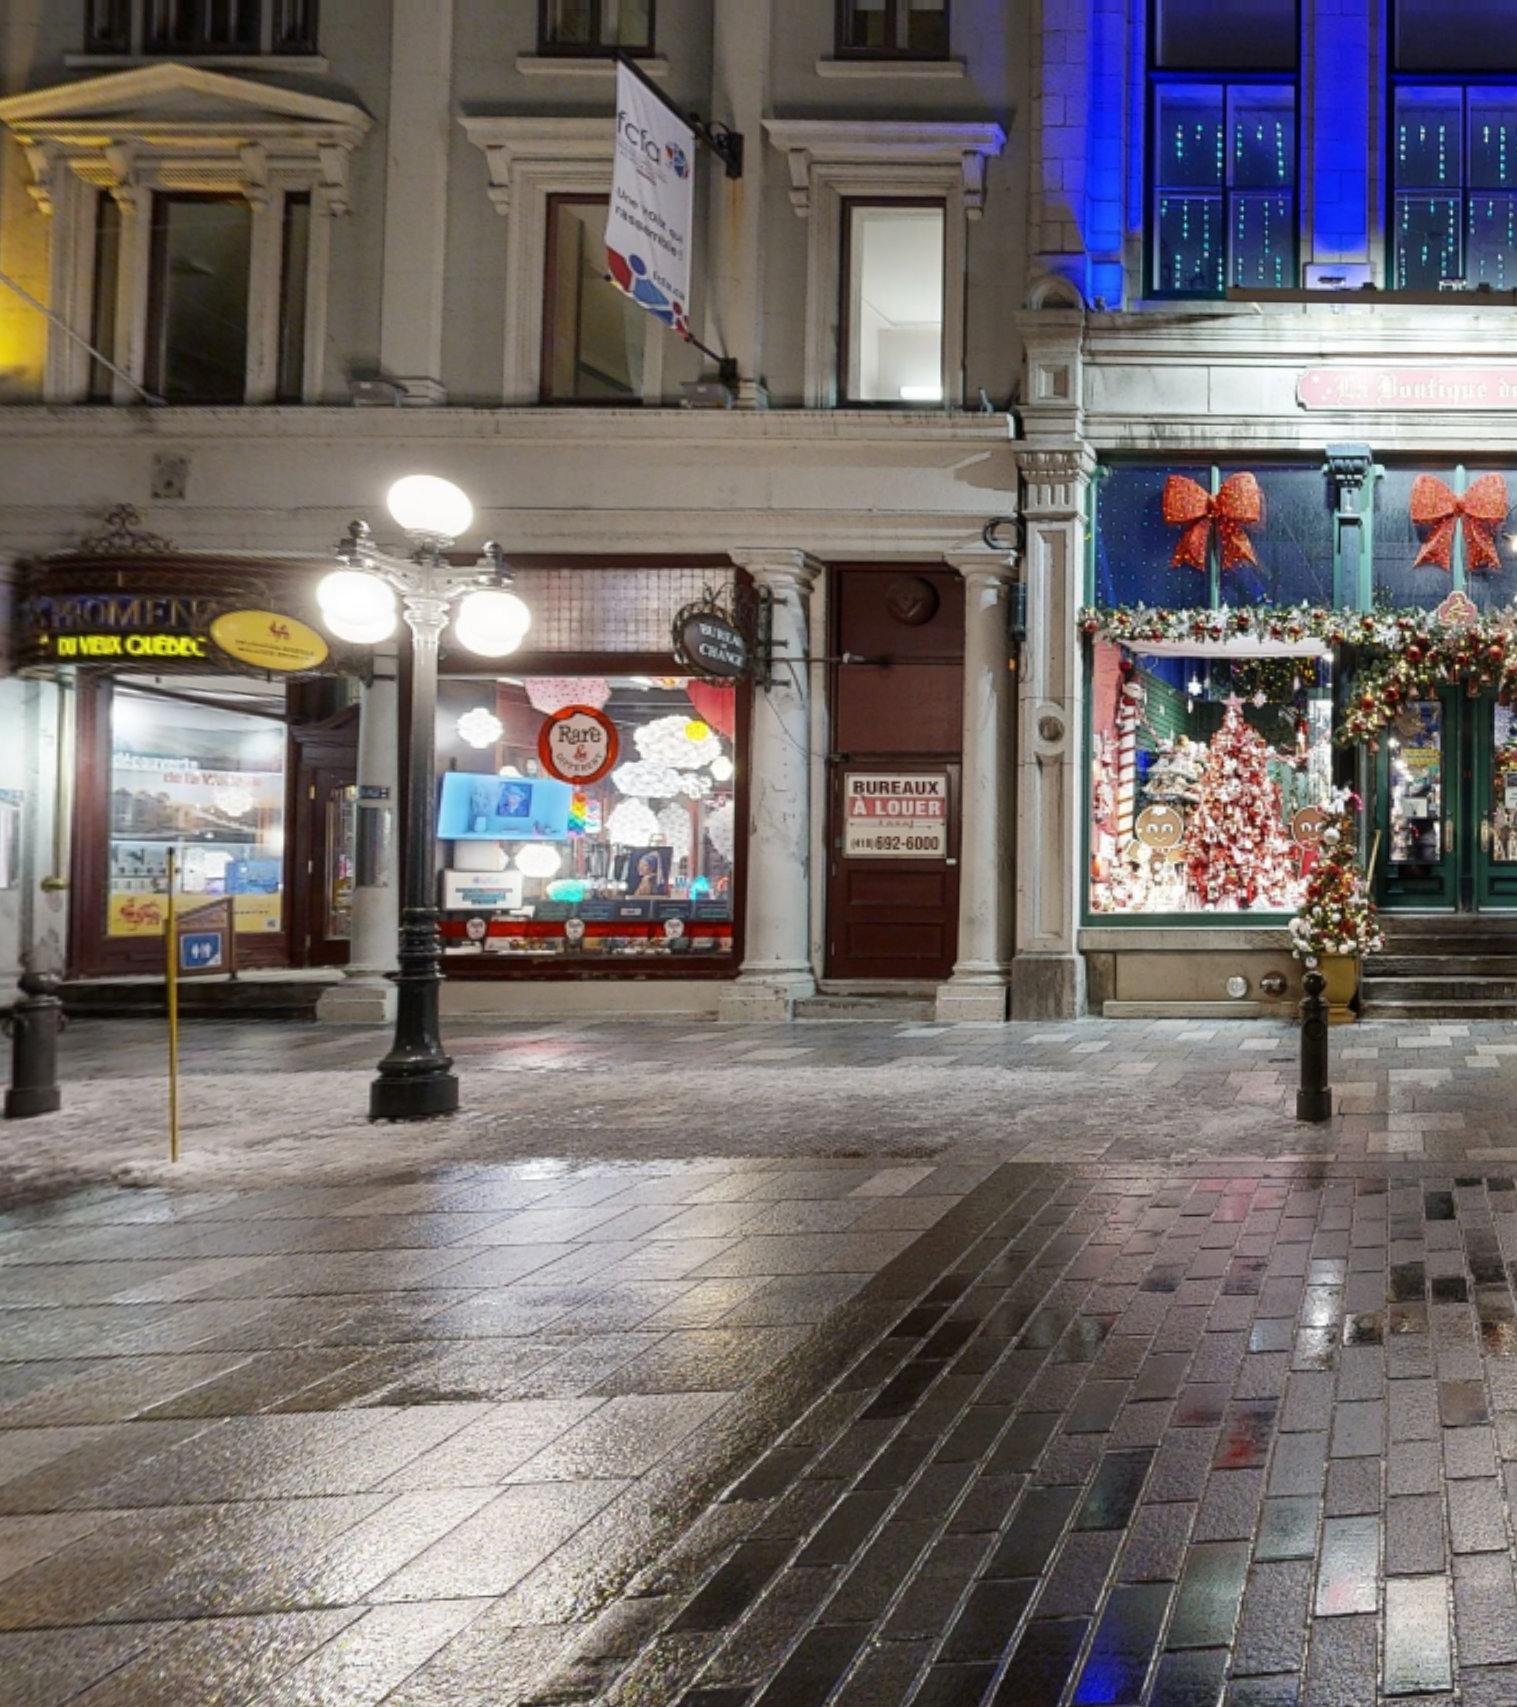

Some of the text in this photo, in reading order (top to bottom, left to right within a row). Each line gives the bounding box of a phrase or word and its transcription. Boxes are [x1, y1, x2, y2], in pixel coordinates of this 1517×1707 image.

[618, 111, 661, 165] fcfa
[616, 186, 639, 209] Une
[642, 205, 667, 230] voix
[1335, 373, 1368, 402] La
[1376, 371, 1488, 405] Boutique
[558, 724, 602, 745] Rare
[852, 780, 939, 795] BUREAUX
[852, 794, 941, 816] À LOUER
